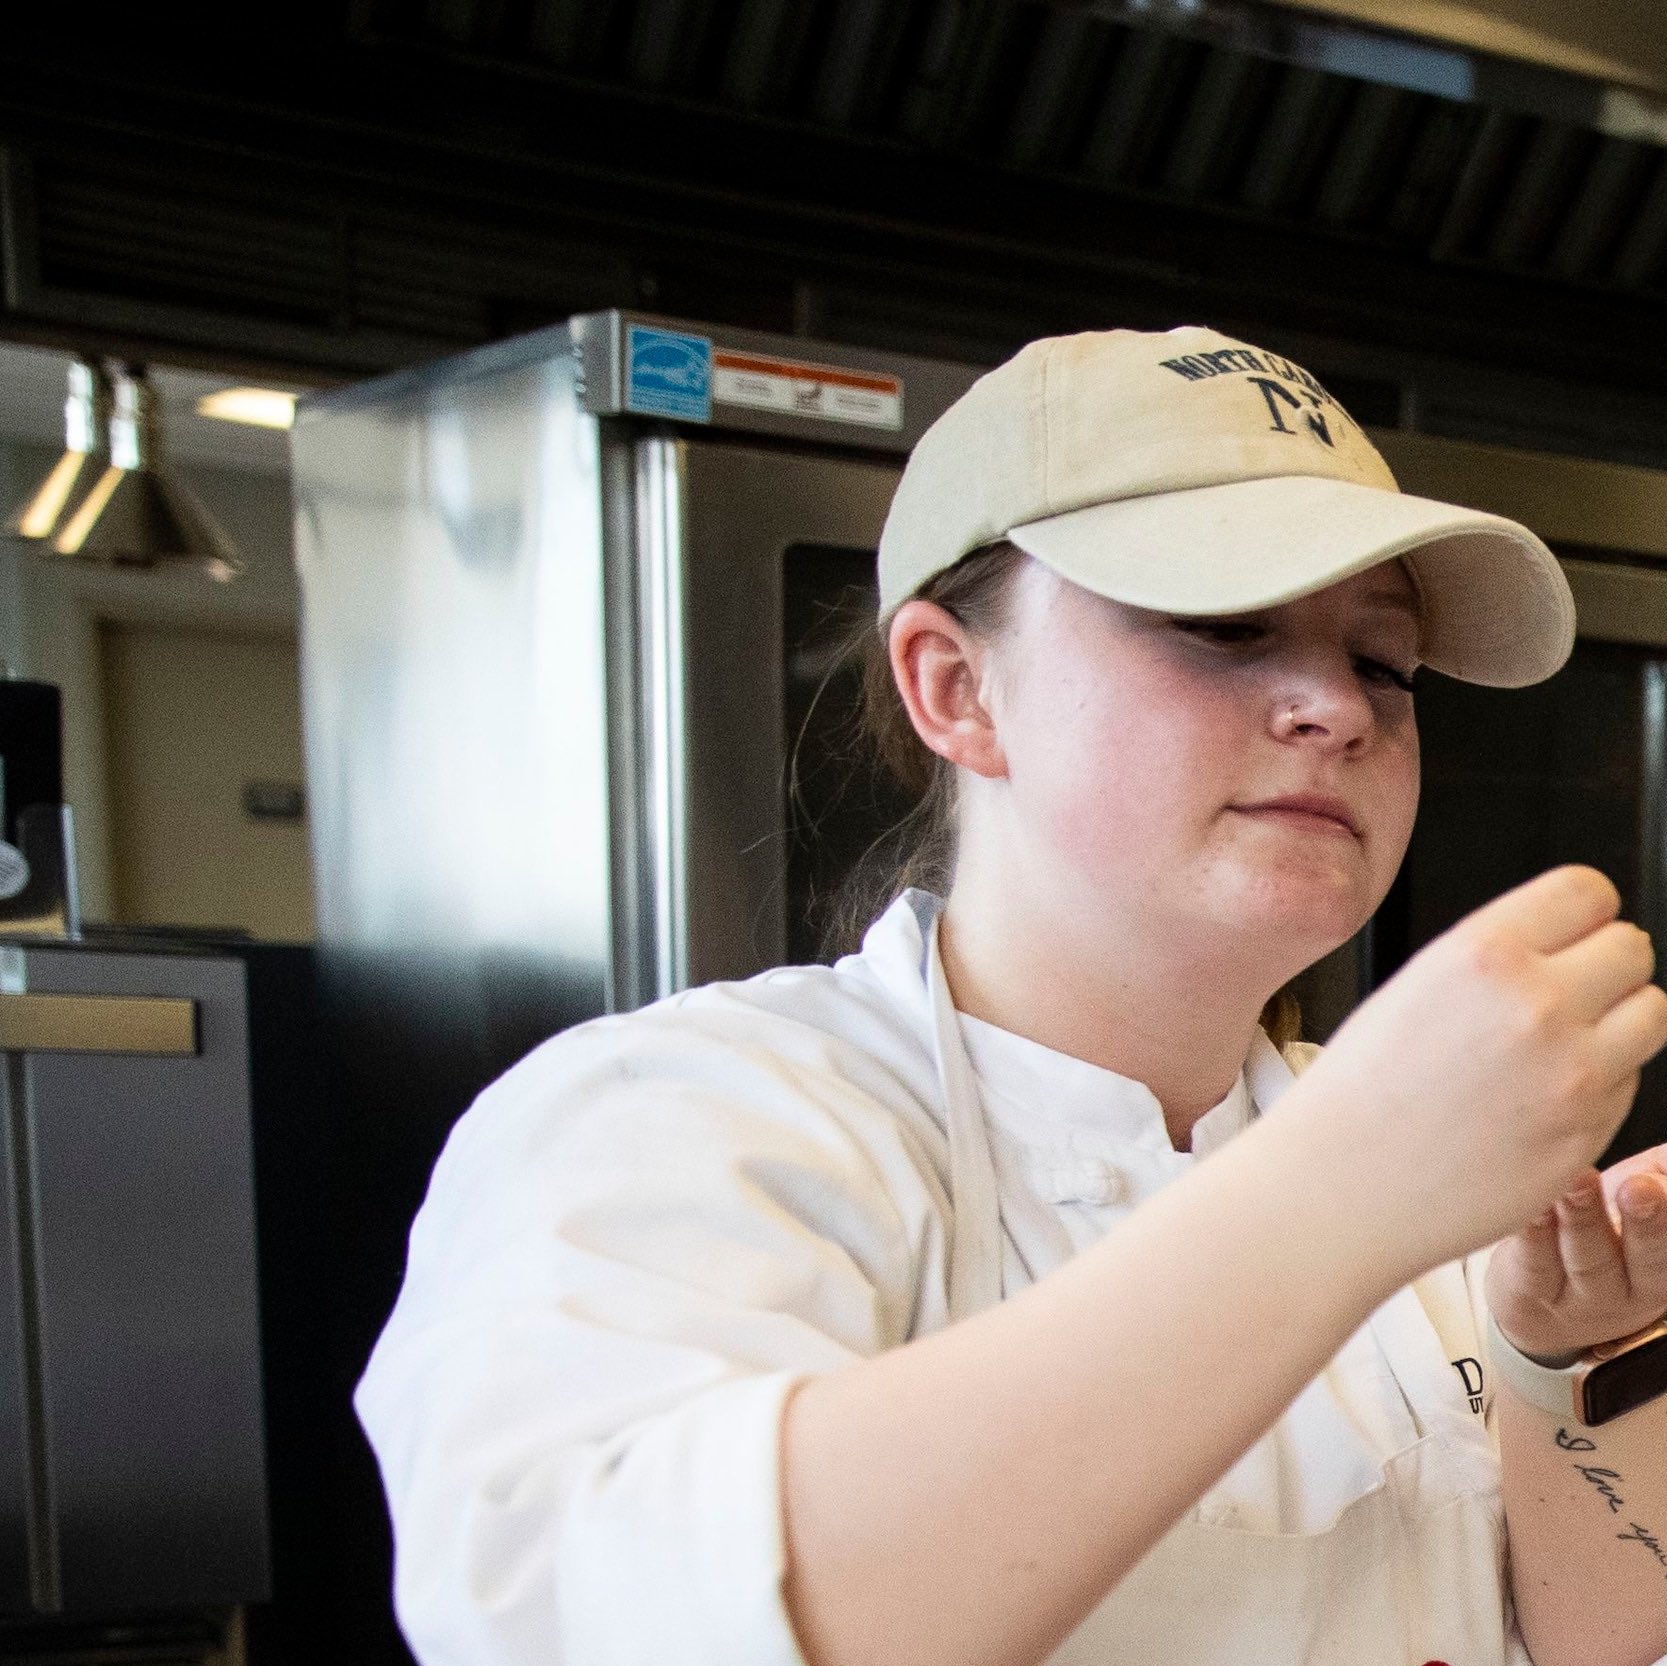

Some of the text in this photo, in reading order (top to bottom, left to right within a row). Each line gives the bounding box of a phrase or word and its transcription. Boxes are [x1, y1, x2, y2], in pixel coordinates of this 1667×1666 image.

[1158, 348, 1270, 381] NORTH
[1573, 1464, 1624, 1514] love
[1616, 1522, 1667, 1567] you
